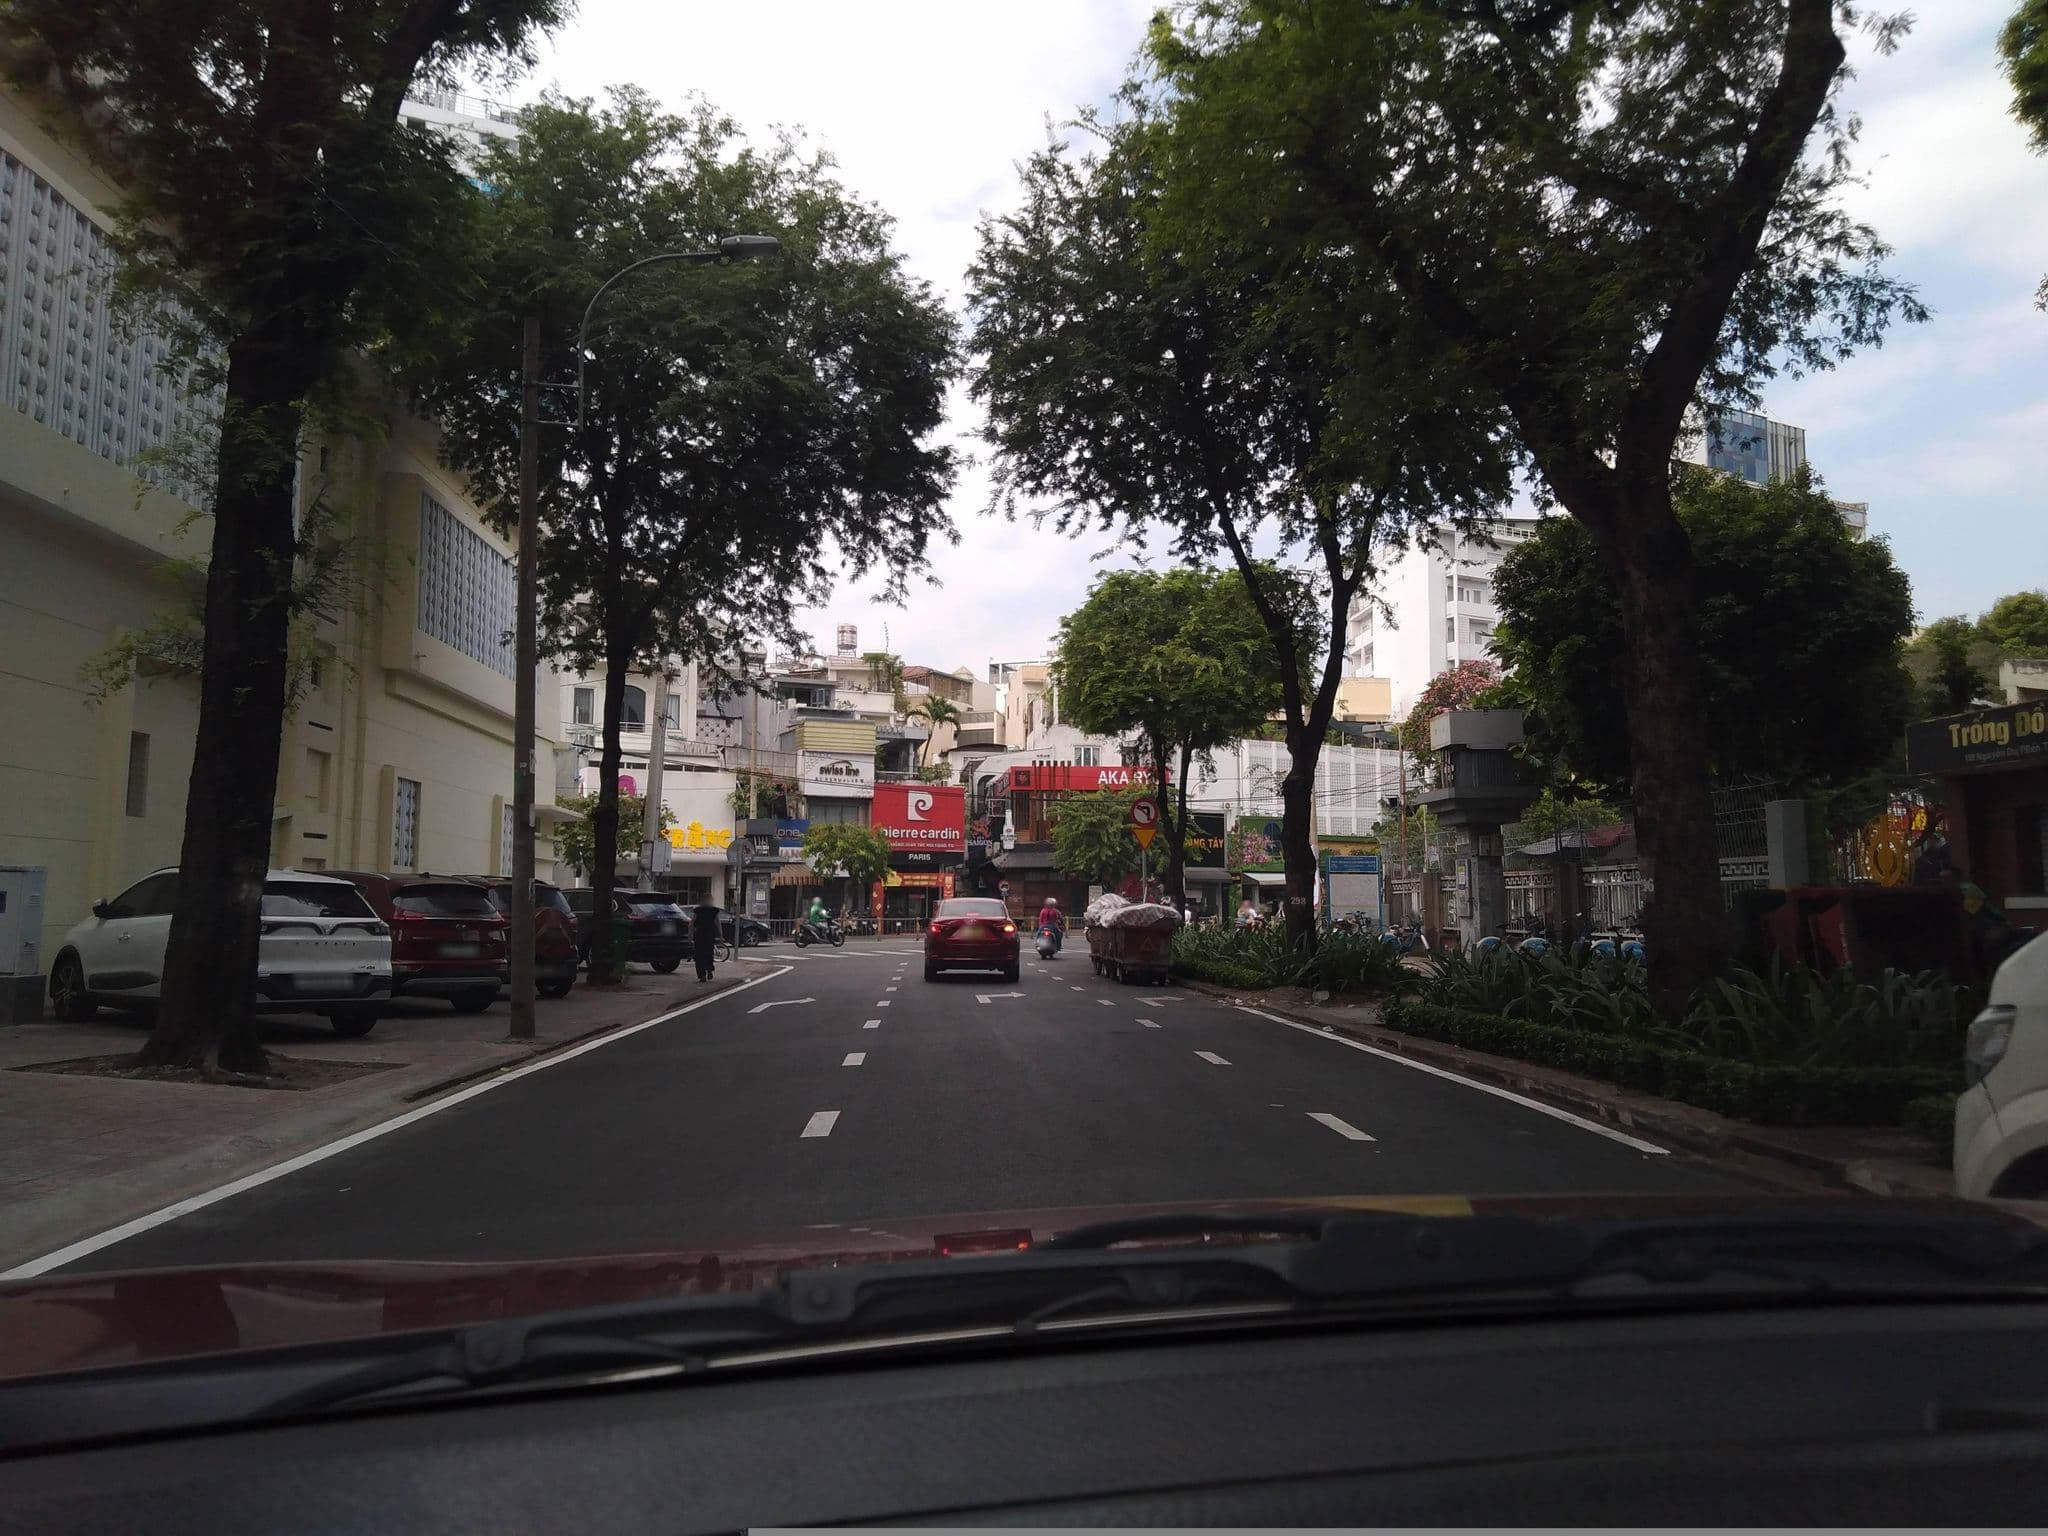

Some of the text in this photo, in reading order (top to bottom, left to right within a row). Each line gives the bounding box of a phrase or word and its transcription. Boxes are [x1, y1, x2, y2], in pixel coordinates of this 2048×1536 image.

[2015, 702, 2048, 737] Đồ
[819, 765, 860, 777] swiss line
[1097, 770, 1129, 785] AKA
[919, 827, 960, 840] cardin
[908, 853, 931, 861] PARIS
